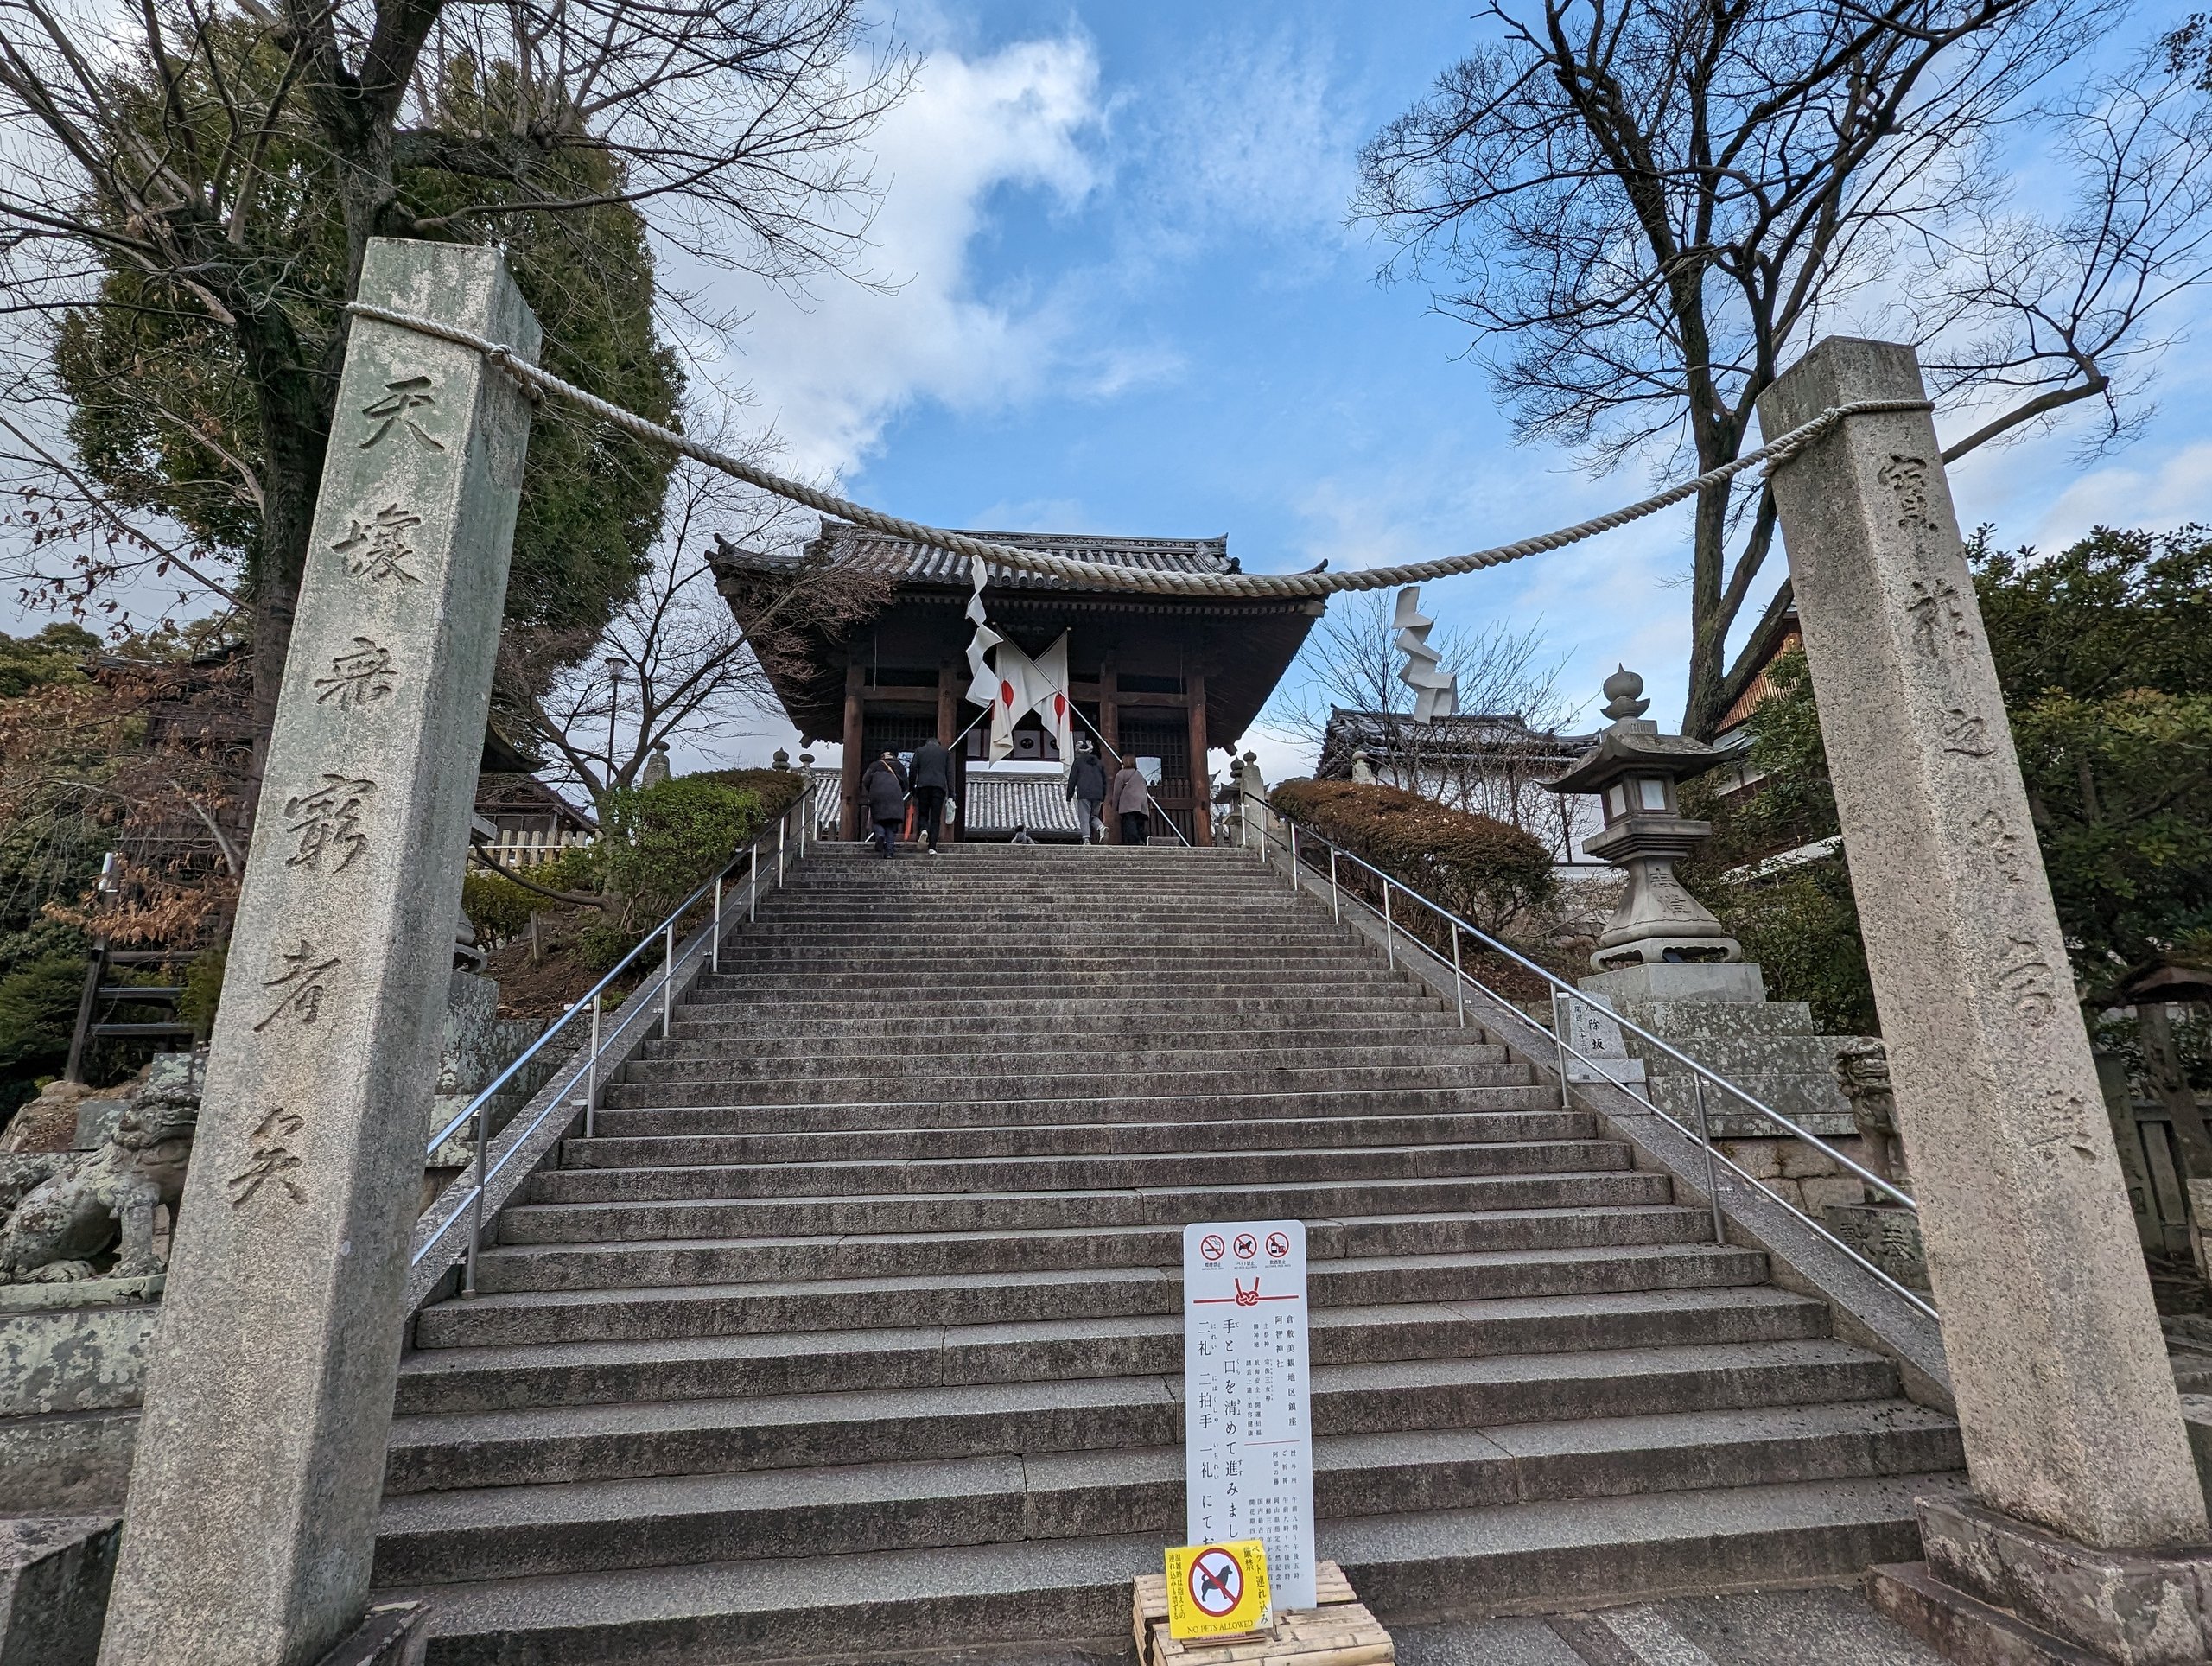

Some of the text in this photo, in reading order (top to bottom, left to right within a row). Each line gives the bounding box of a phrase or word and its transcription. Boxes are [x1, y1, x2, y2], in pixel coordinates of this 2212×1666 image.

[1198, 1321, 1211, 1356] 二礼
[1274, 1315, 1284, 1368] 阿智神社
[1286, 1314, 1297, 1427] 倉敷美観地区鎮座
[1198, 1372, 1212, 1429] 二拍手
[1223, 1318, 1239, 1539] 手と口を清めて進みまし
[1200, 1447, 1213, 1478] 一礼
[1251, 1545, 1270, 1625] ペット連れ込み
[1186, 1619, 1254, 1634] NO PETS ALLOWED
